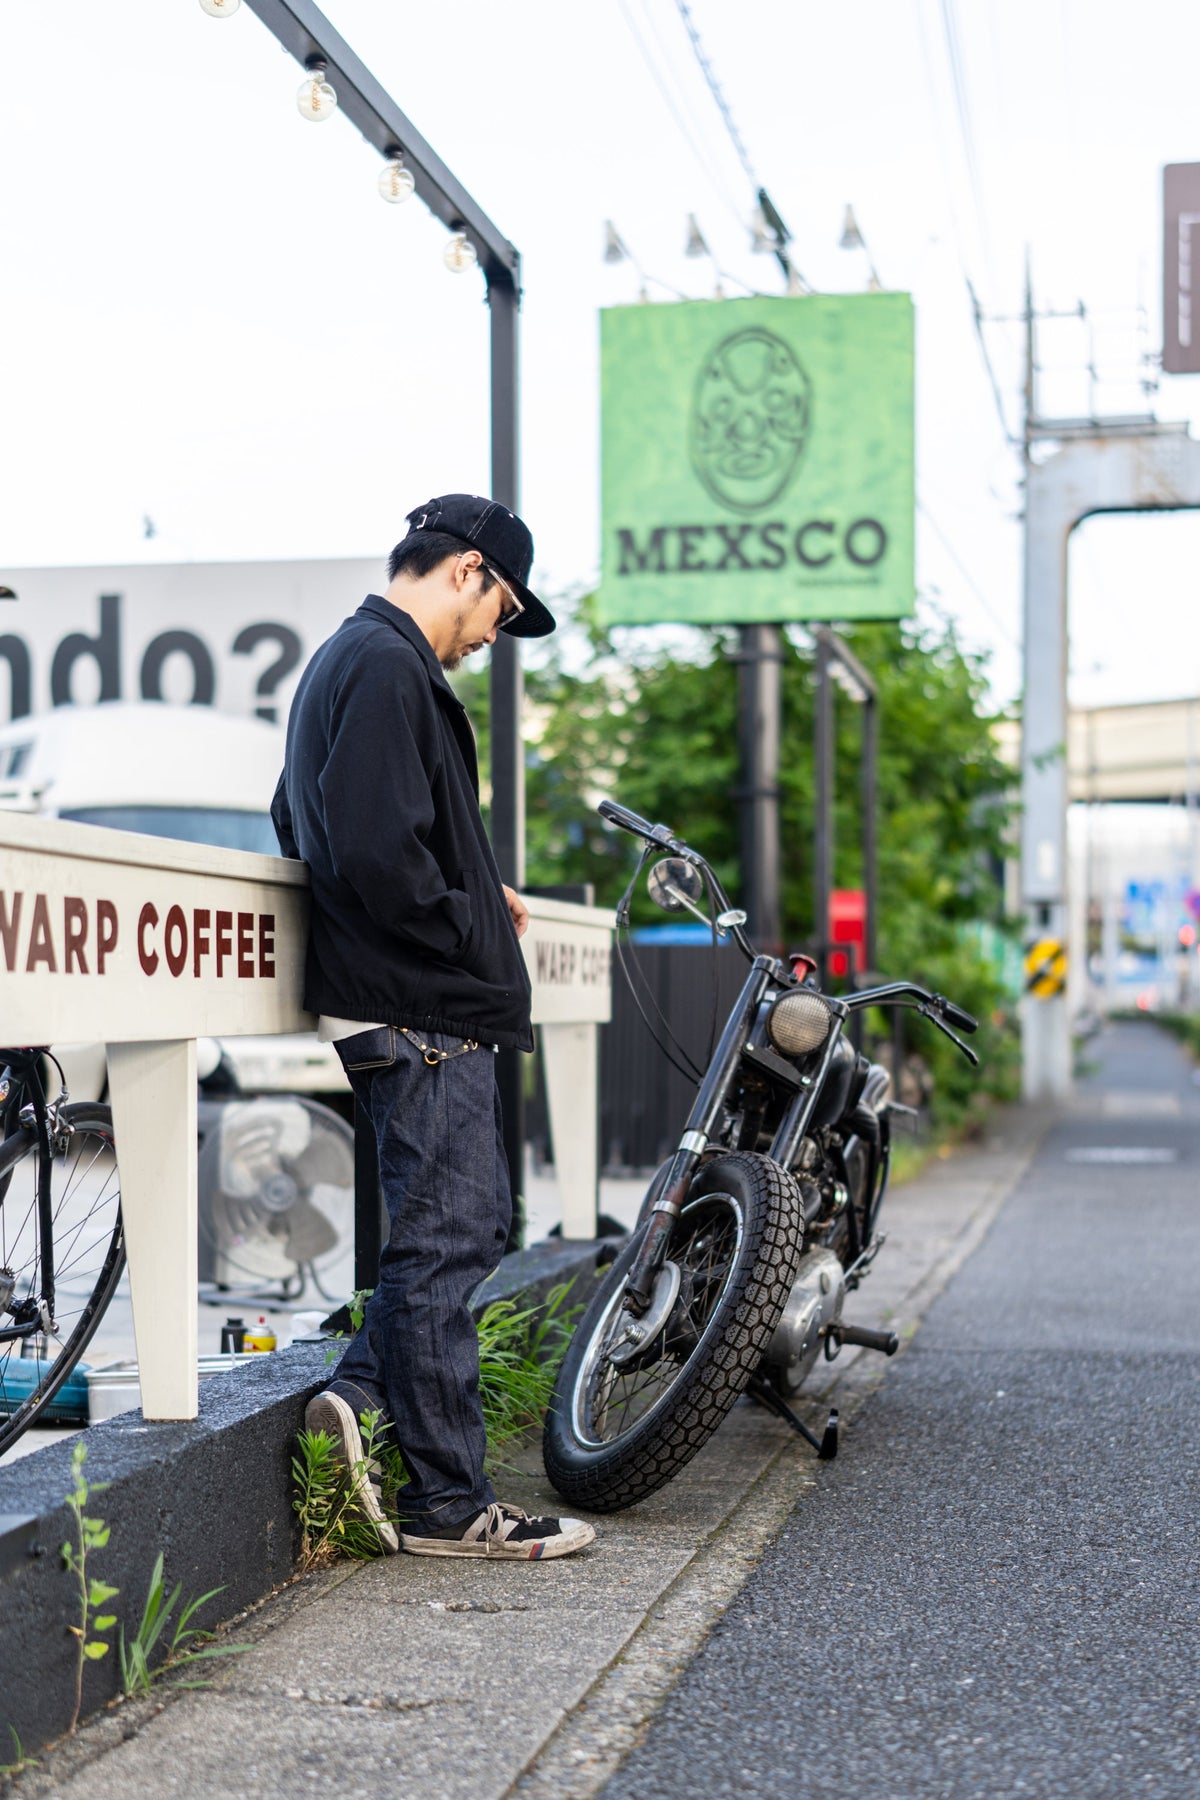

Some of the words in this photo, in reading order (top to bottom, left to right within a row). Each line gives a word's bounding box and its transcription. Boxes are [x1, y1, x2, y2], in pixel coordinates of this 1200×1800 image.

[615, 517, 889, 577] MEXSCO
[137, 901, 276, 979] COFFEE
[536, 941, 576, 985] WARP
